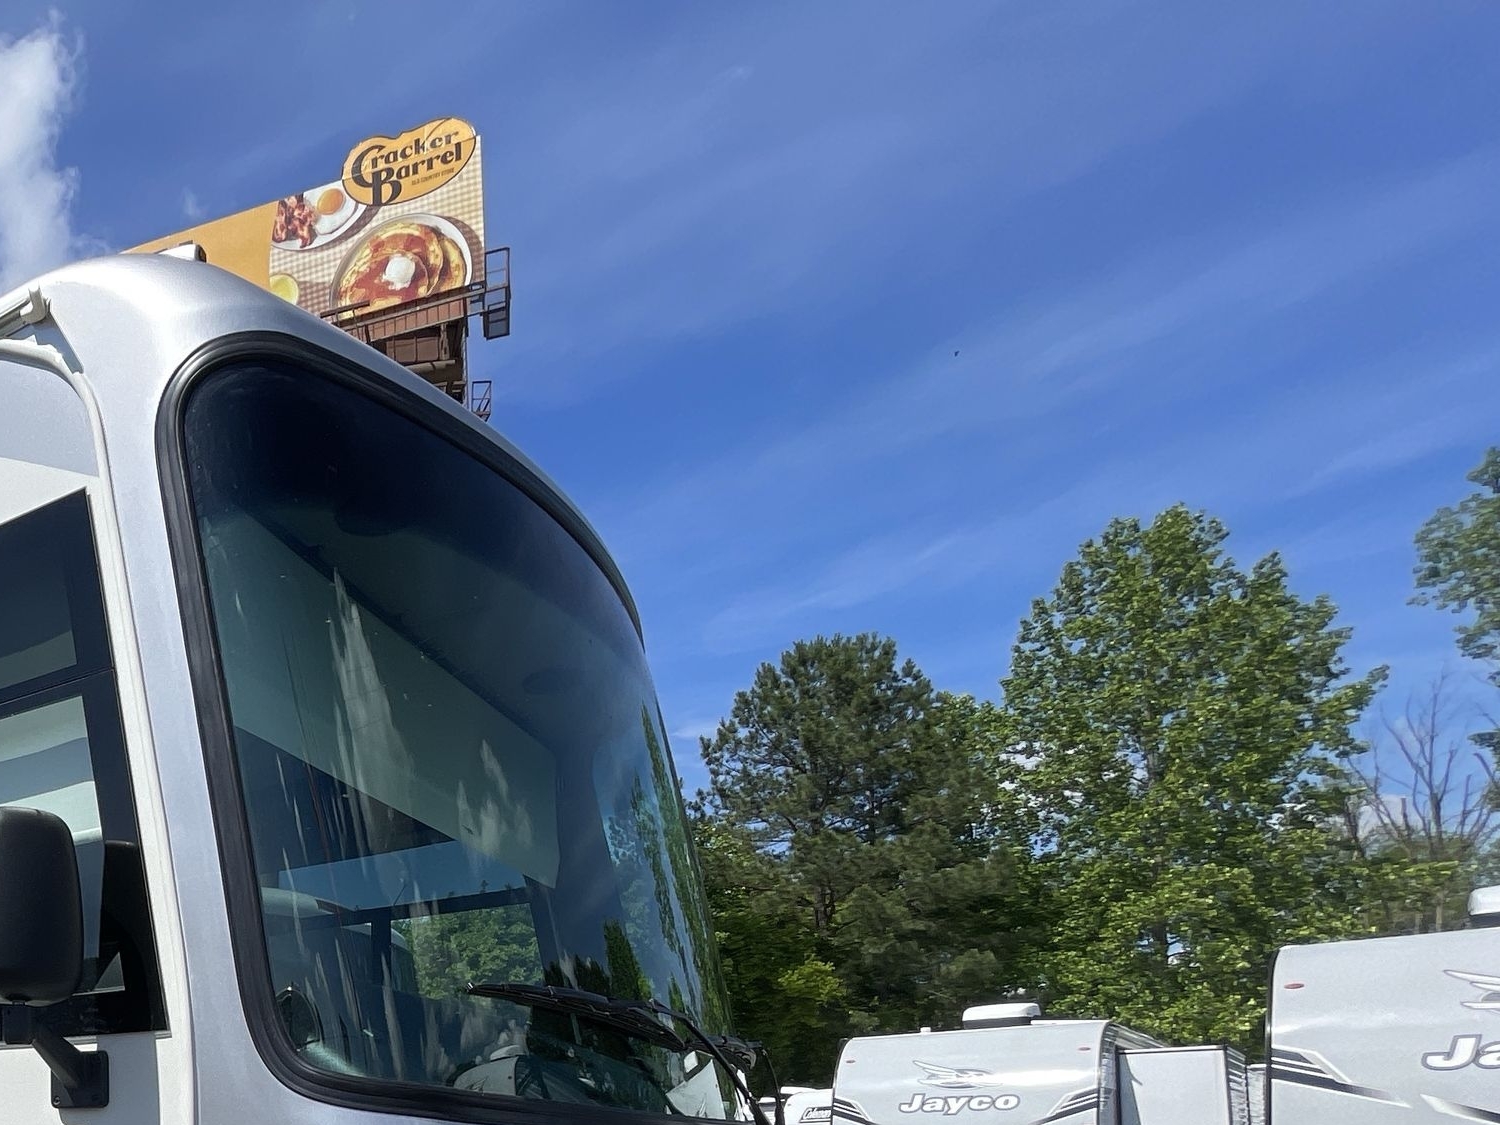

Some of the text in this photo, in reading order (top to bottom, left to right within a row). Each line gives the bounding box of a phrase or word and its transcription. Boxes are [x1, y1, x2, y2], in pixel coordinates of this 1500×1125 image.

[351, 131, 459, 188] Cracker
[371, 141, 462, 206] Barrel
[898, 1093, 1020, 1115] Jayco
